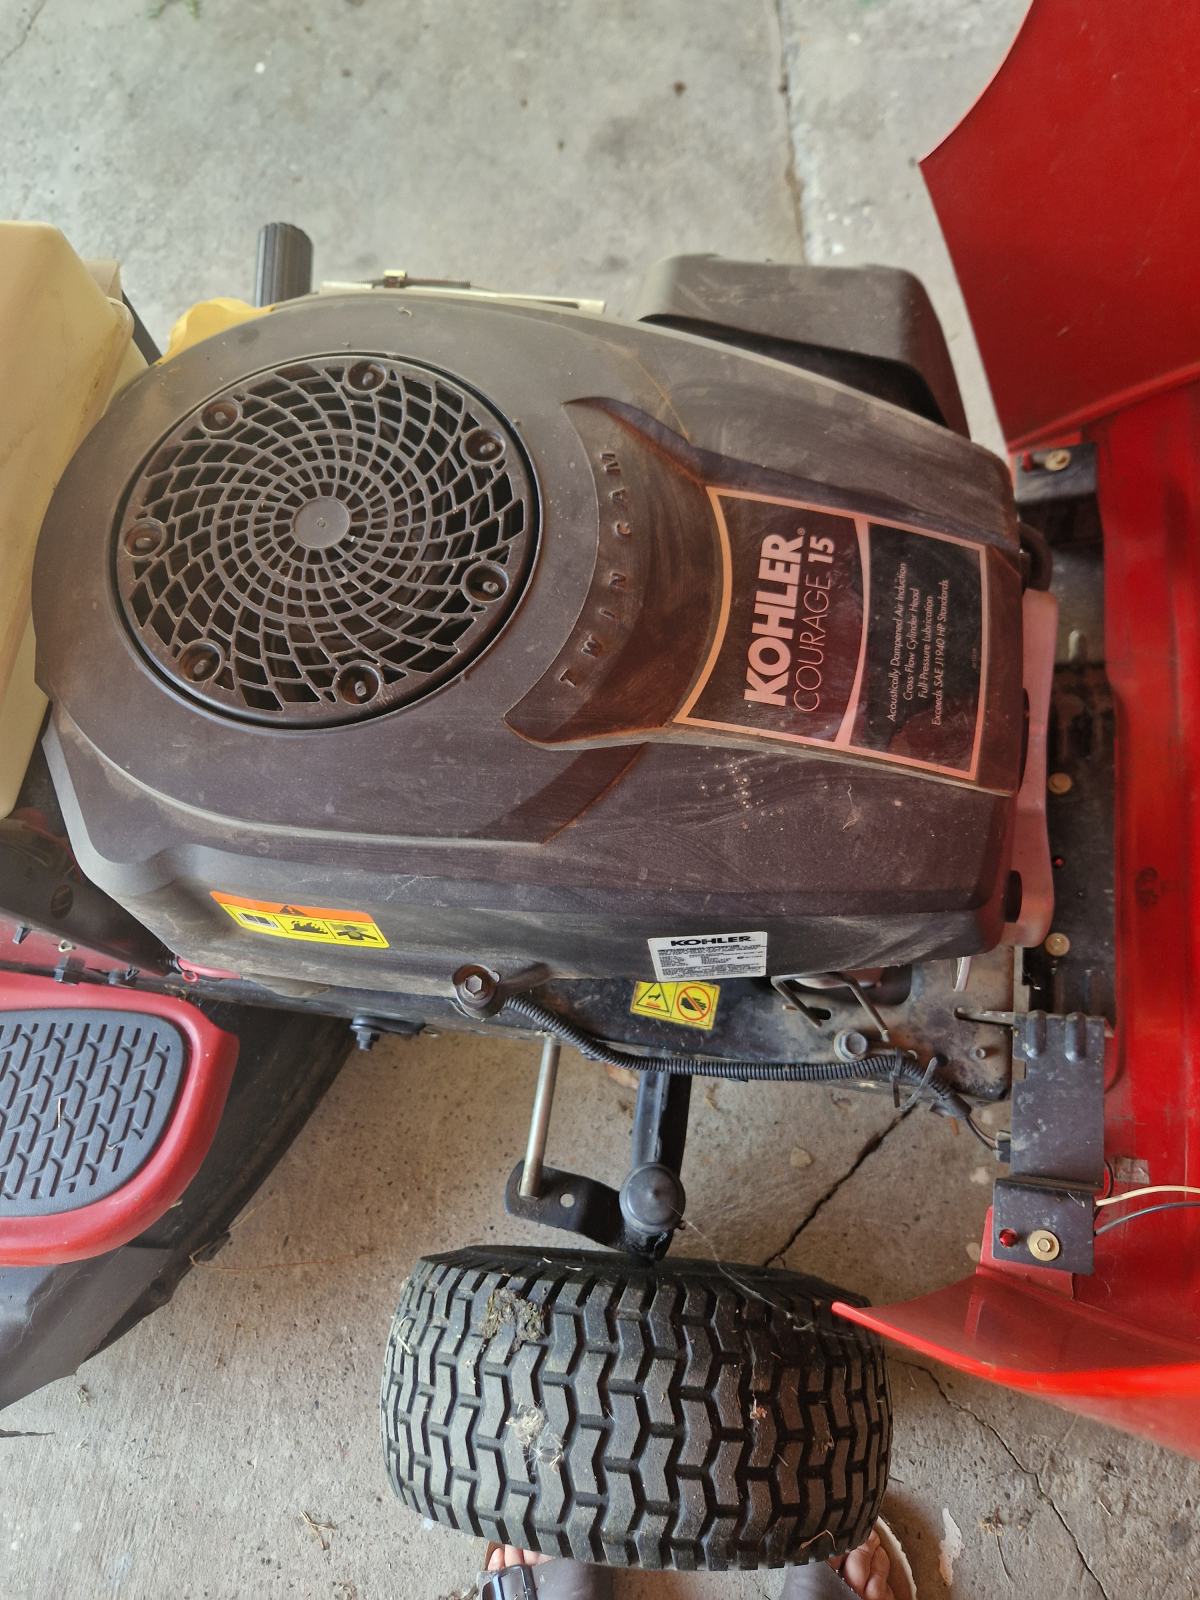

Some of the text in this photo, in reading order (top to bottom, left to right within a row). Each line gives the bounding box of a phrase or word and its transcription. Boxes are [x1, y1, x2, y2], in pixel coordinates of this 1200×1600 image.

[558, 451, 631, 688] TWIN CAM
[793, 536, 834, 712] COURAGE 15
[887, 562, 906, 721] Acoustically Dampened Air Induction
[903, 588, 919, 700] Cross-Flow Cylinder Head
[918, 596, 933, 699] Full-Pressure Lubrication
[932, 579, 948, 725] Exceeds SAE J1940 HP Standards
[671, 936, 751, 946] KOHLER
